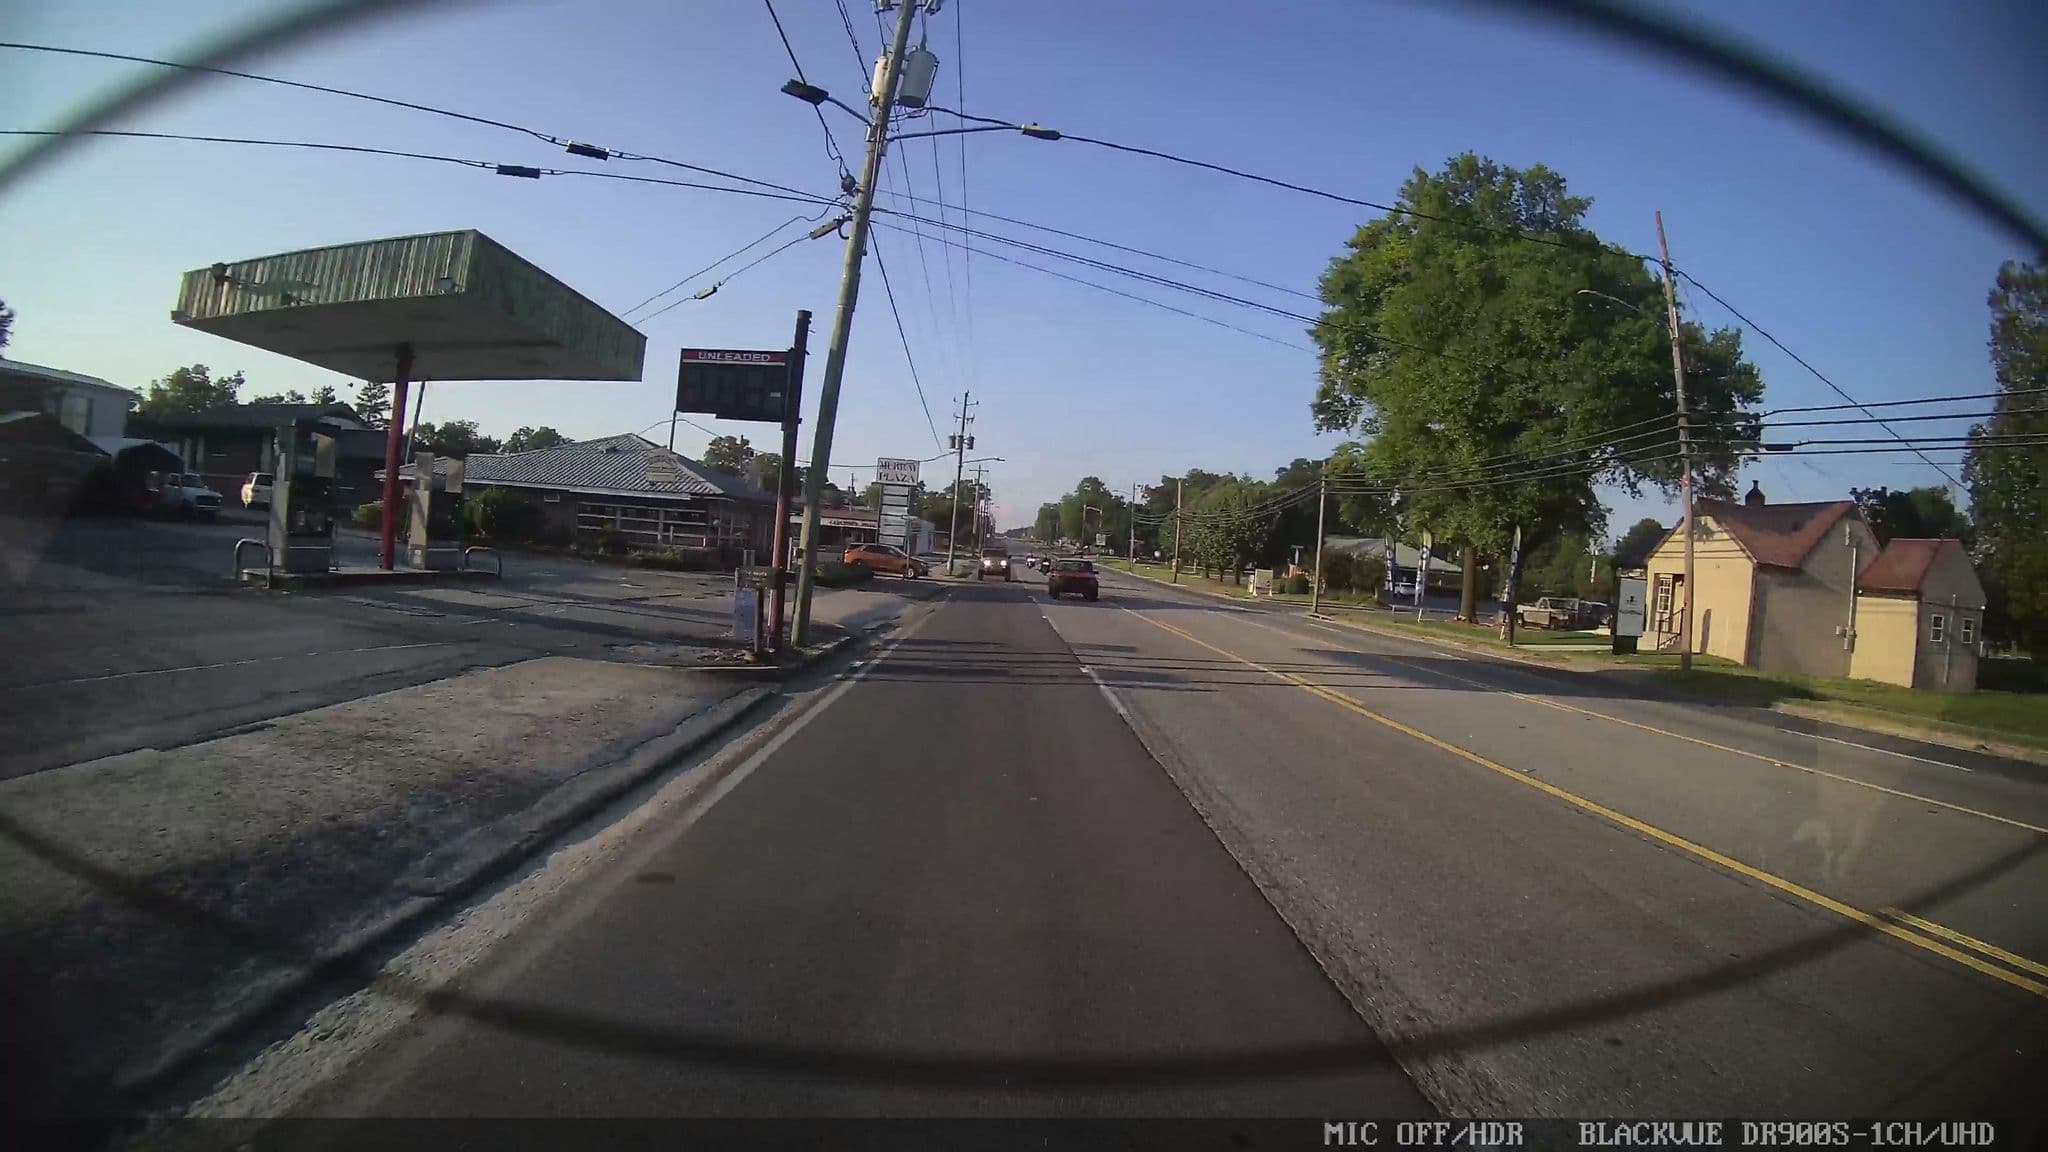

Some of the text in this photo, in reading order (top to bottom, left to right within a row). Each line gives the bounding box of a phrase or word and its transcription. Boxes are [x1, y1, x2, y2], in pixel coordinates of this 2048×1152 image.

[698, 351, 771, 362] UNLEADED
[880, 460, 918, 472] MURRAY
[879, 471, 916, 483] PLAZA
